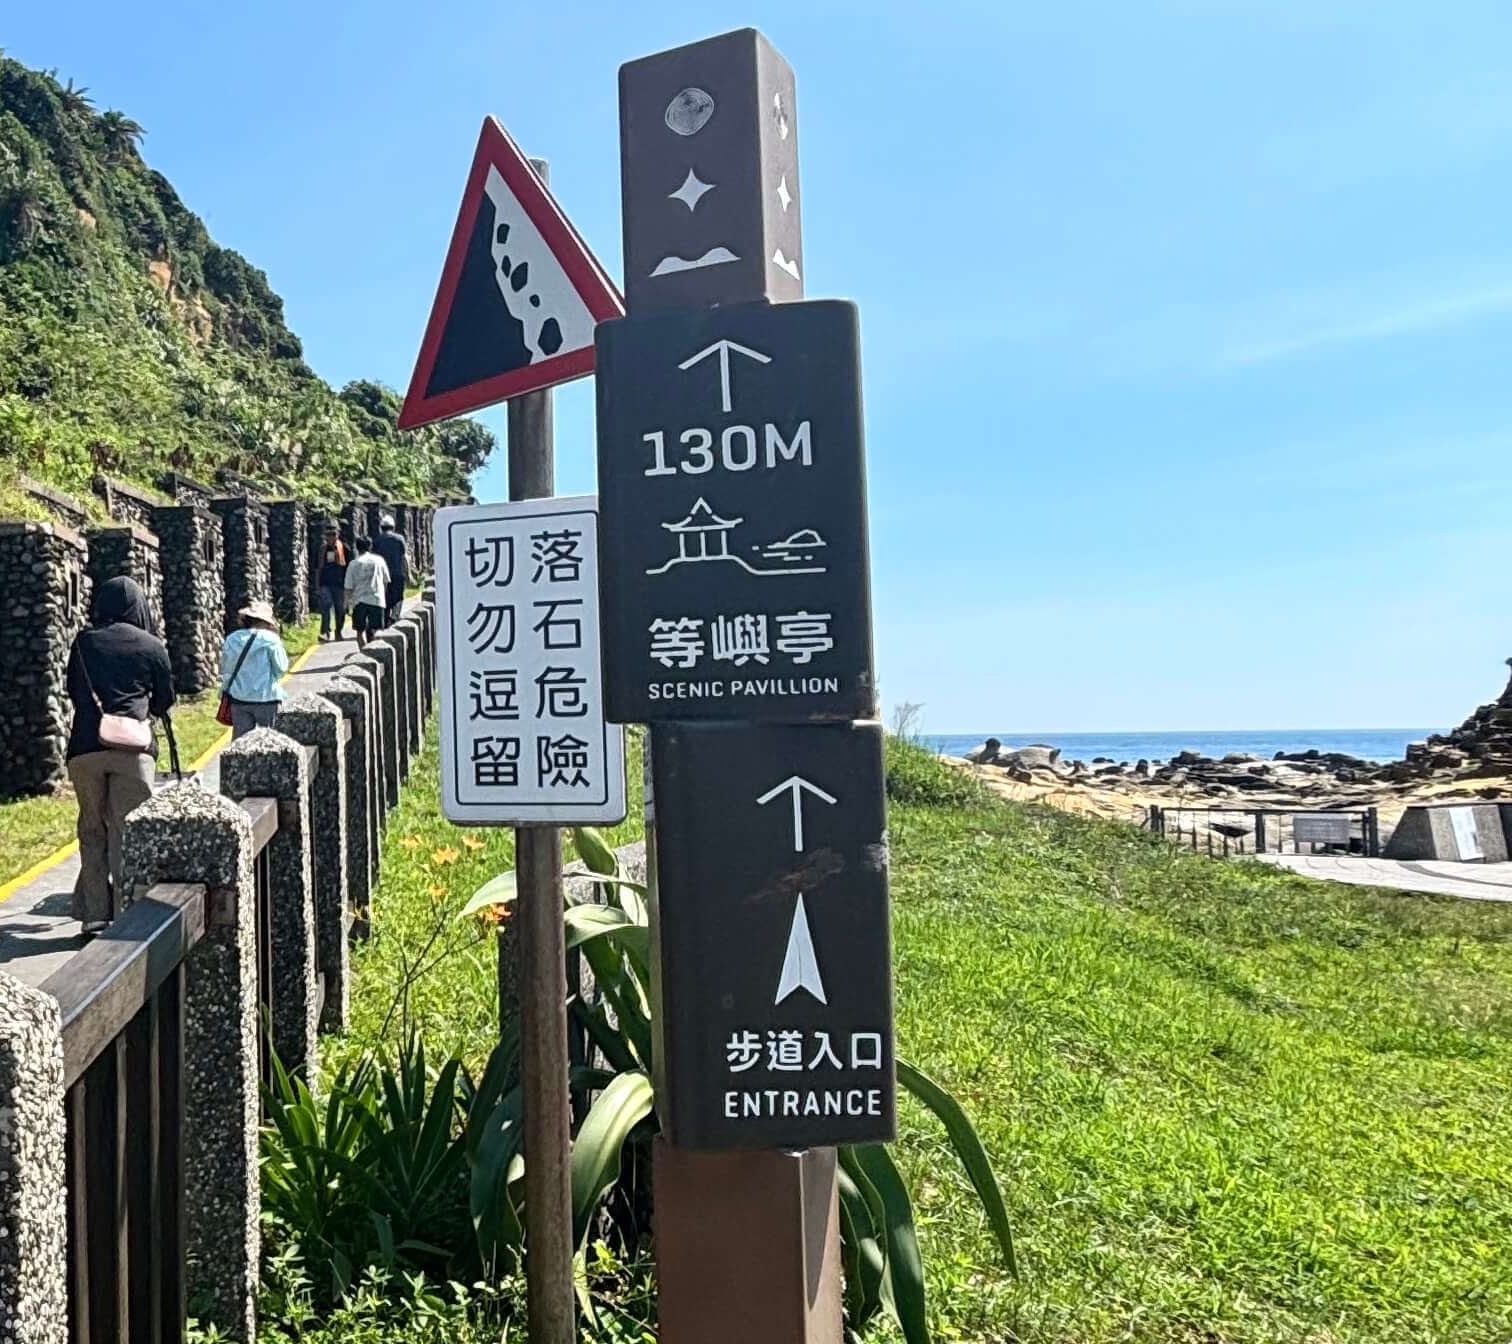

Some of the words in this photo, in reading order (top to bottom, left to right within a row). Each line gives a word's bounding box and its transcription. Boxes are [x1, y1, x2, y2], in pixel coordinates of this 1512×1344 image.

[643, 421, 812, 476] 130M
[465, 536, 521, 787] 切勿逗留
[530, 529, 590, 788] 落石危險
[649, 611, 833, 668] 等嶼亭
[648, 681, 724, 699] SCENIC
[731, 677, 838, 696] PAVILLION
[726, 1030, 882, 1072] 步道入口
[725, 1090, 882, 1117] ENTRANCE
